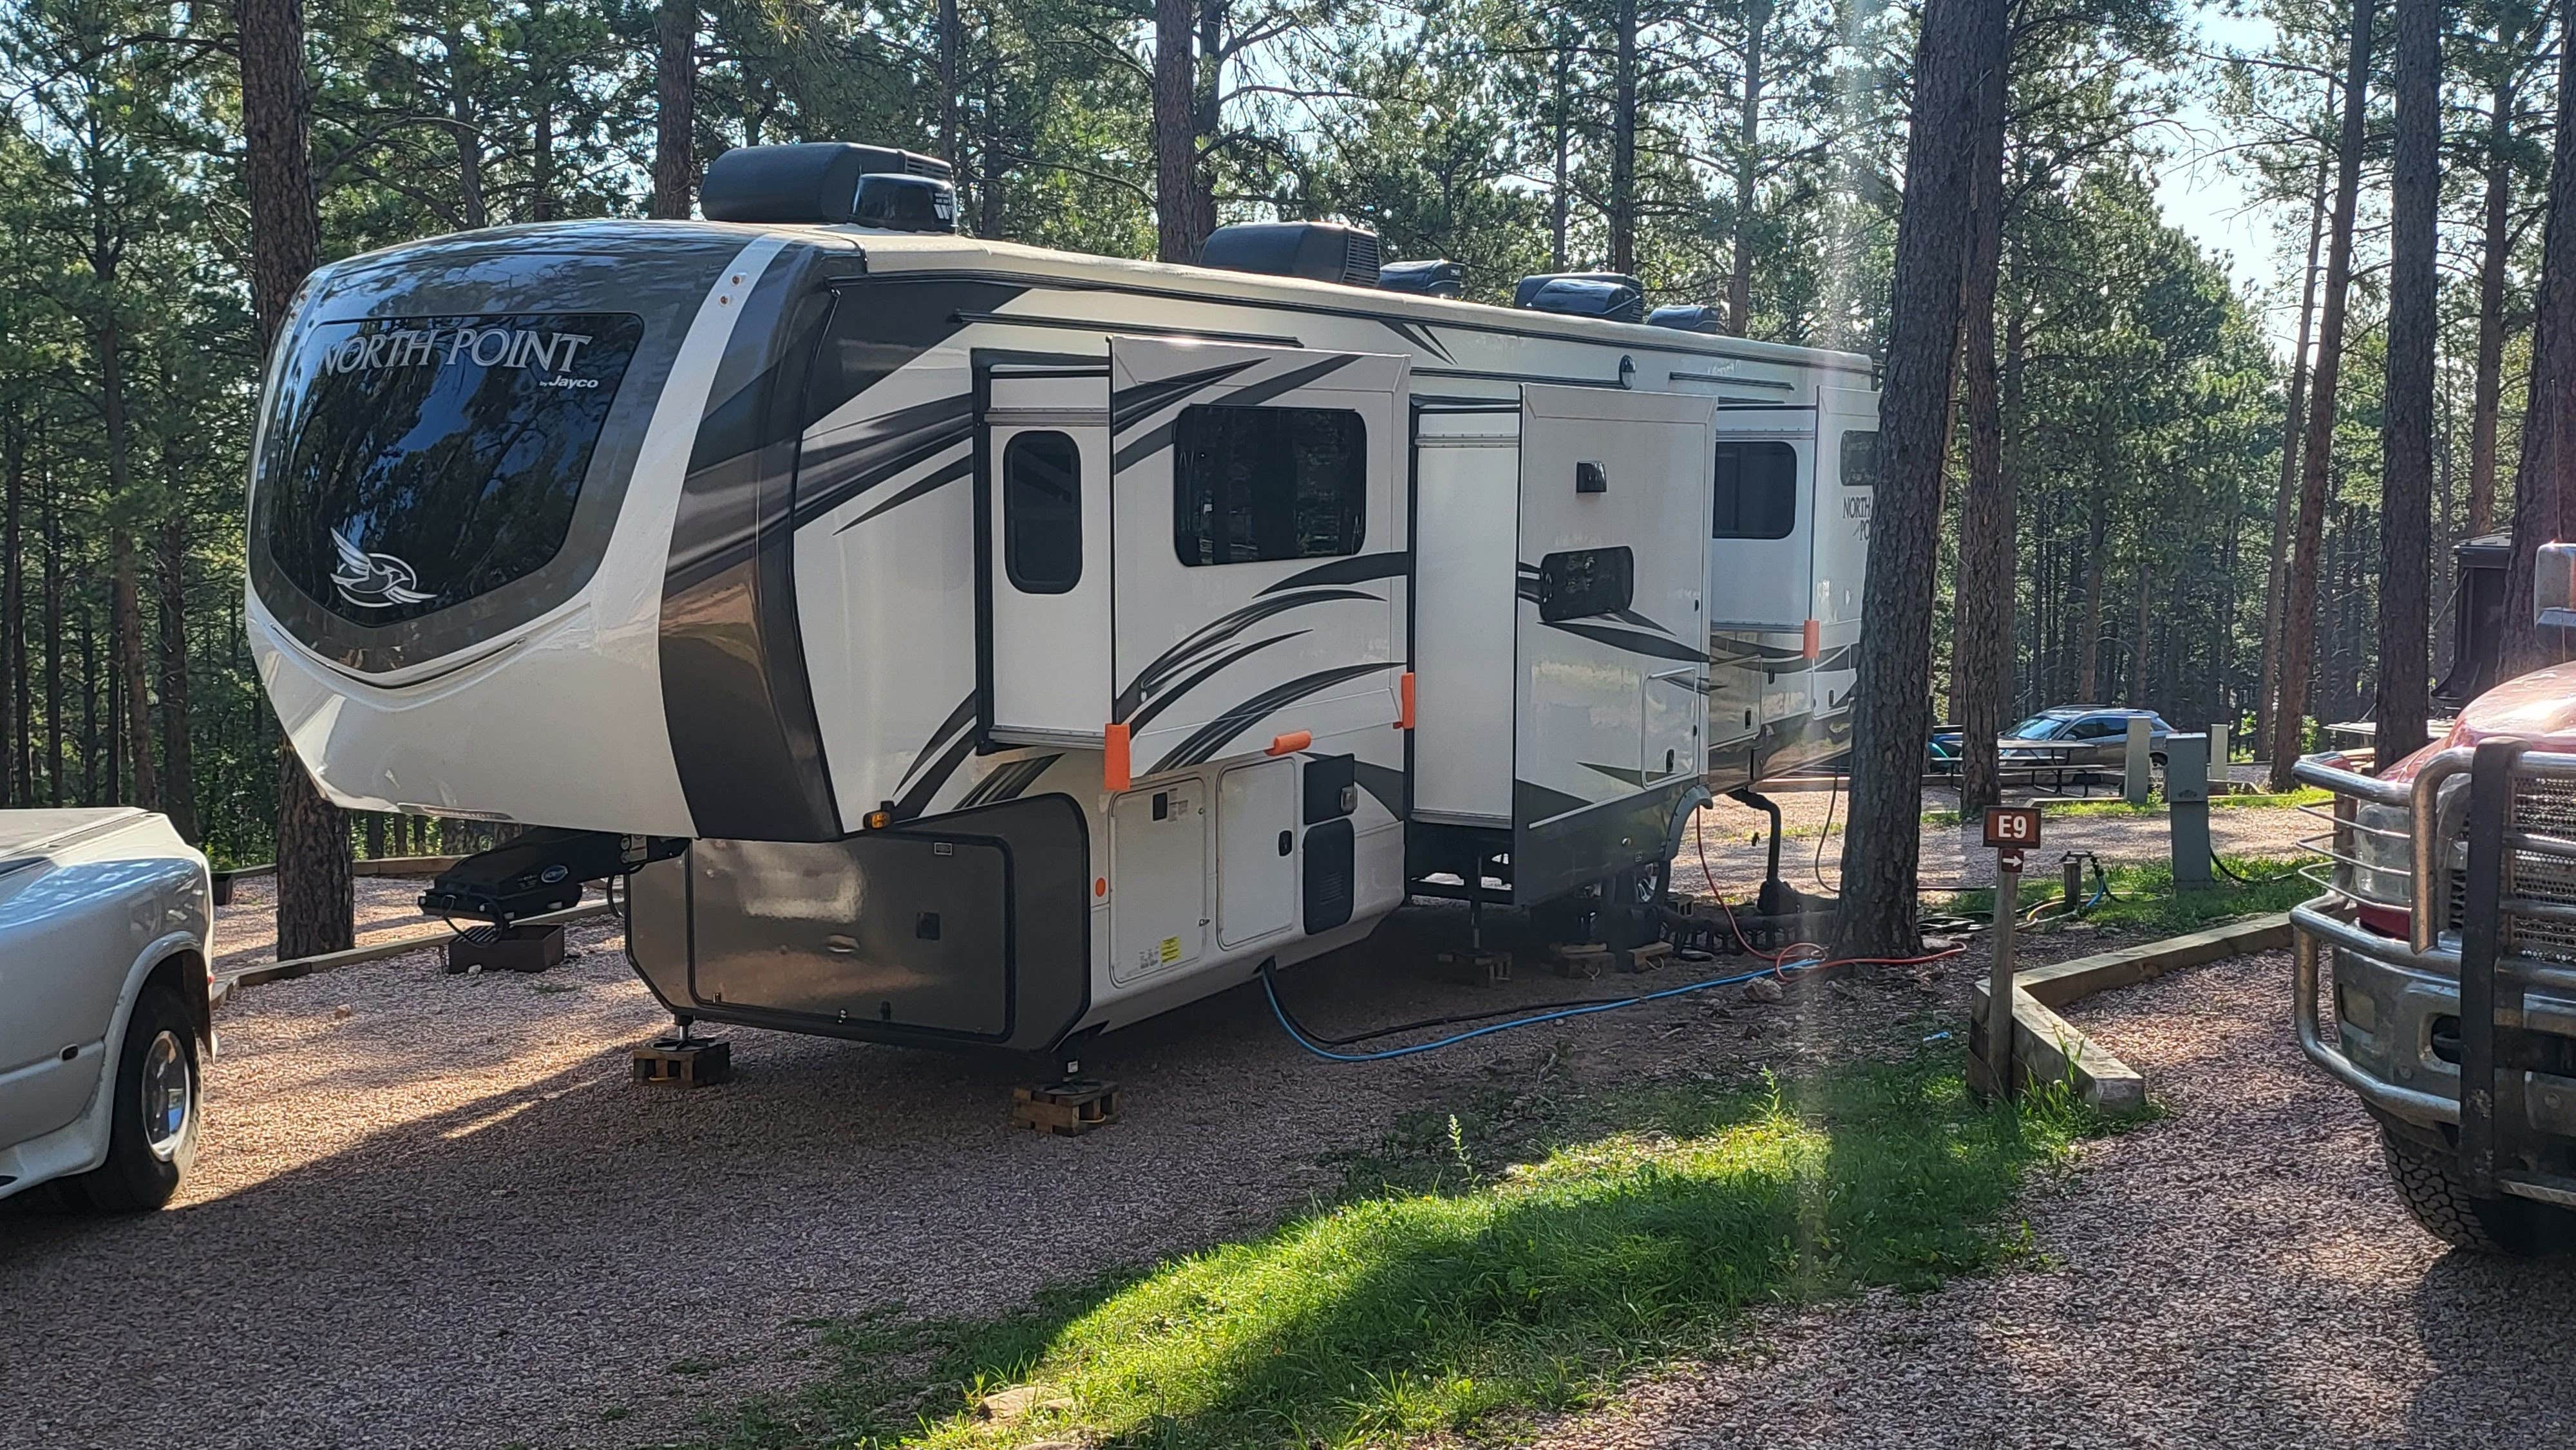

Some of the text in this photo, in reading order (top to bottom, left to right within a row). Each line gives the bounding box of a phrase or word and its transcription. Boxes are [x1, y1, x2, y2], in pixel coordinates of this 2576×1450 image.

[311, 328, 592, 379] NORTH POINT
[549, 375, 599, 390] Jayco
[1842, 496, 1871, 519] NORTH
[1998, 815, 2027, 839] E9
